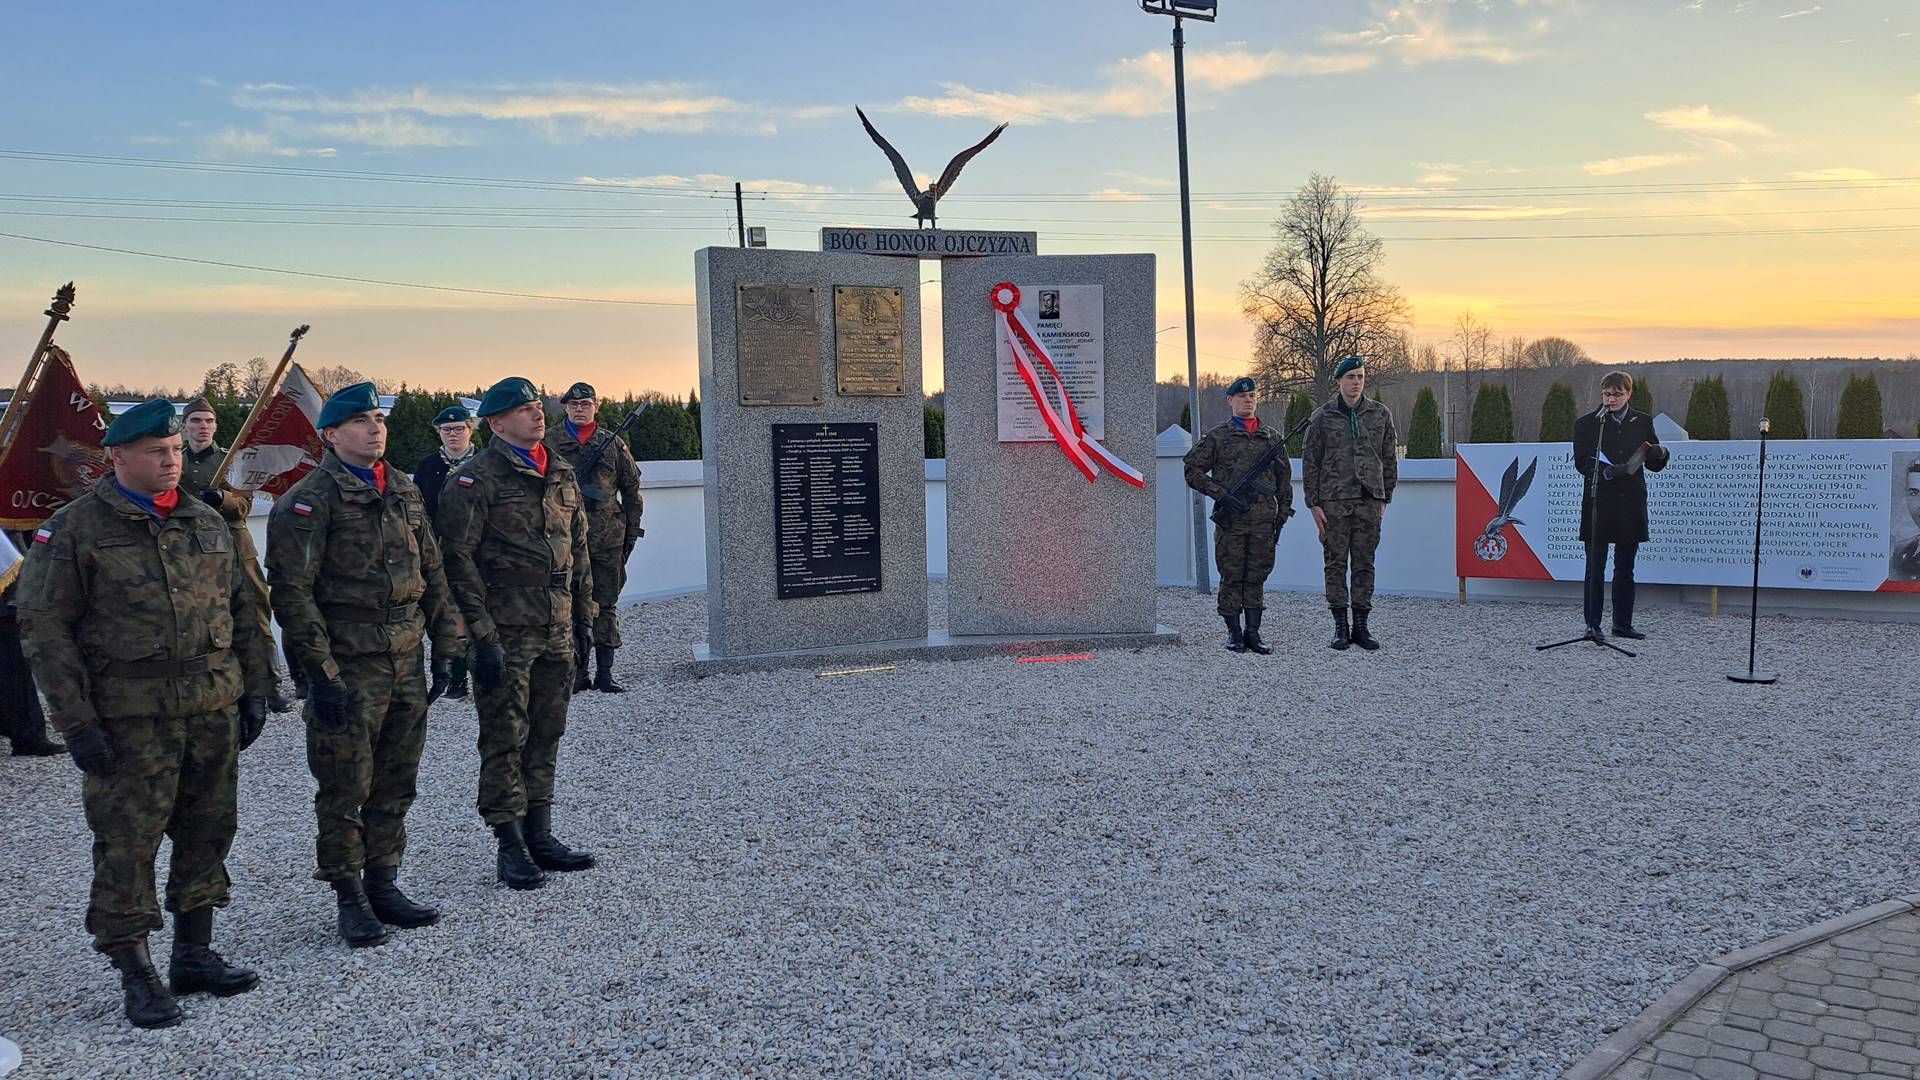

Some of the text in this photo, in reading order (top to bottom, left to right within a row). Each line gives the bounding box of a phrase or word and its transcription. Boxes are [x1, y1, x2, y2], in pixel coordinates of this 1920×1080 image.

[830, 230, 1031, 253] BÓG HONOR OJCZYZNA
[1845, 463, 1888, 471] (POWIAT
[1765, 482, 1827, 490] FRANCUSKIEJ
[1819, 492, 1855, 500] SZTABU
[1805, 501, 1879, 510] CICHOCIEMNY,
[1650, 509, 1730, 518] WARSZAWSKIEGO,
[1732, 510, 1753, 518] SZEF
[1787, 520, 1816, 528] ARMII
[1819, 521, 1873, 530] KRAJOWEJ,
[1649, 527, 1684, 535] RAKÓW
[1687, 528, 1744, 537] DELEGATURY
[1763, 529, 1822, 539] ZBROJNYCH,
[1825, 532, 1880, 540] INSPEKTOR
[1665, 537, 1734, 546] NARODOWYCH
[1673, 546, 1707, 554] SZTABU
[1710, 548, 1772, 556] NACZELNGO
[1775, 549, 1815, 557] WODZA,
[1818, 551, 1867, 559] POZOSTAŁ
[1680, 556, 1714, 565] SPRING
[1716, 557, 1737, 565] HILL
